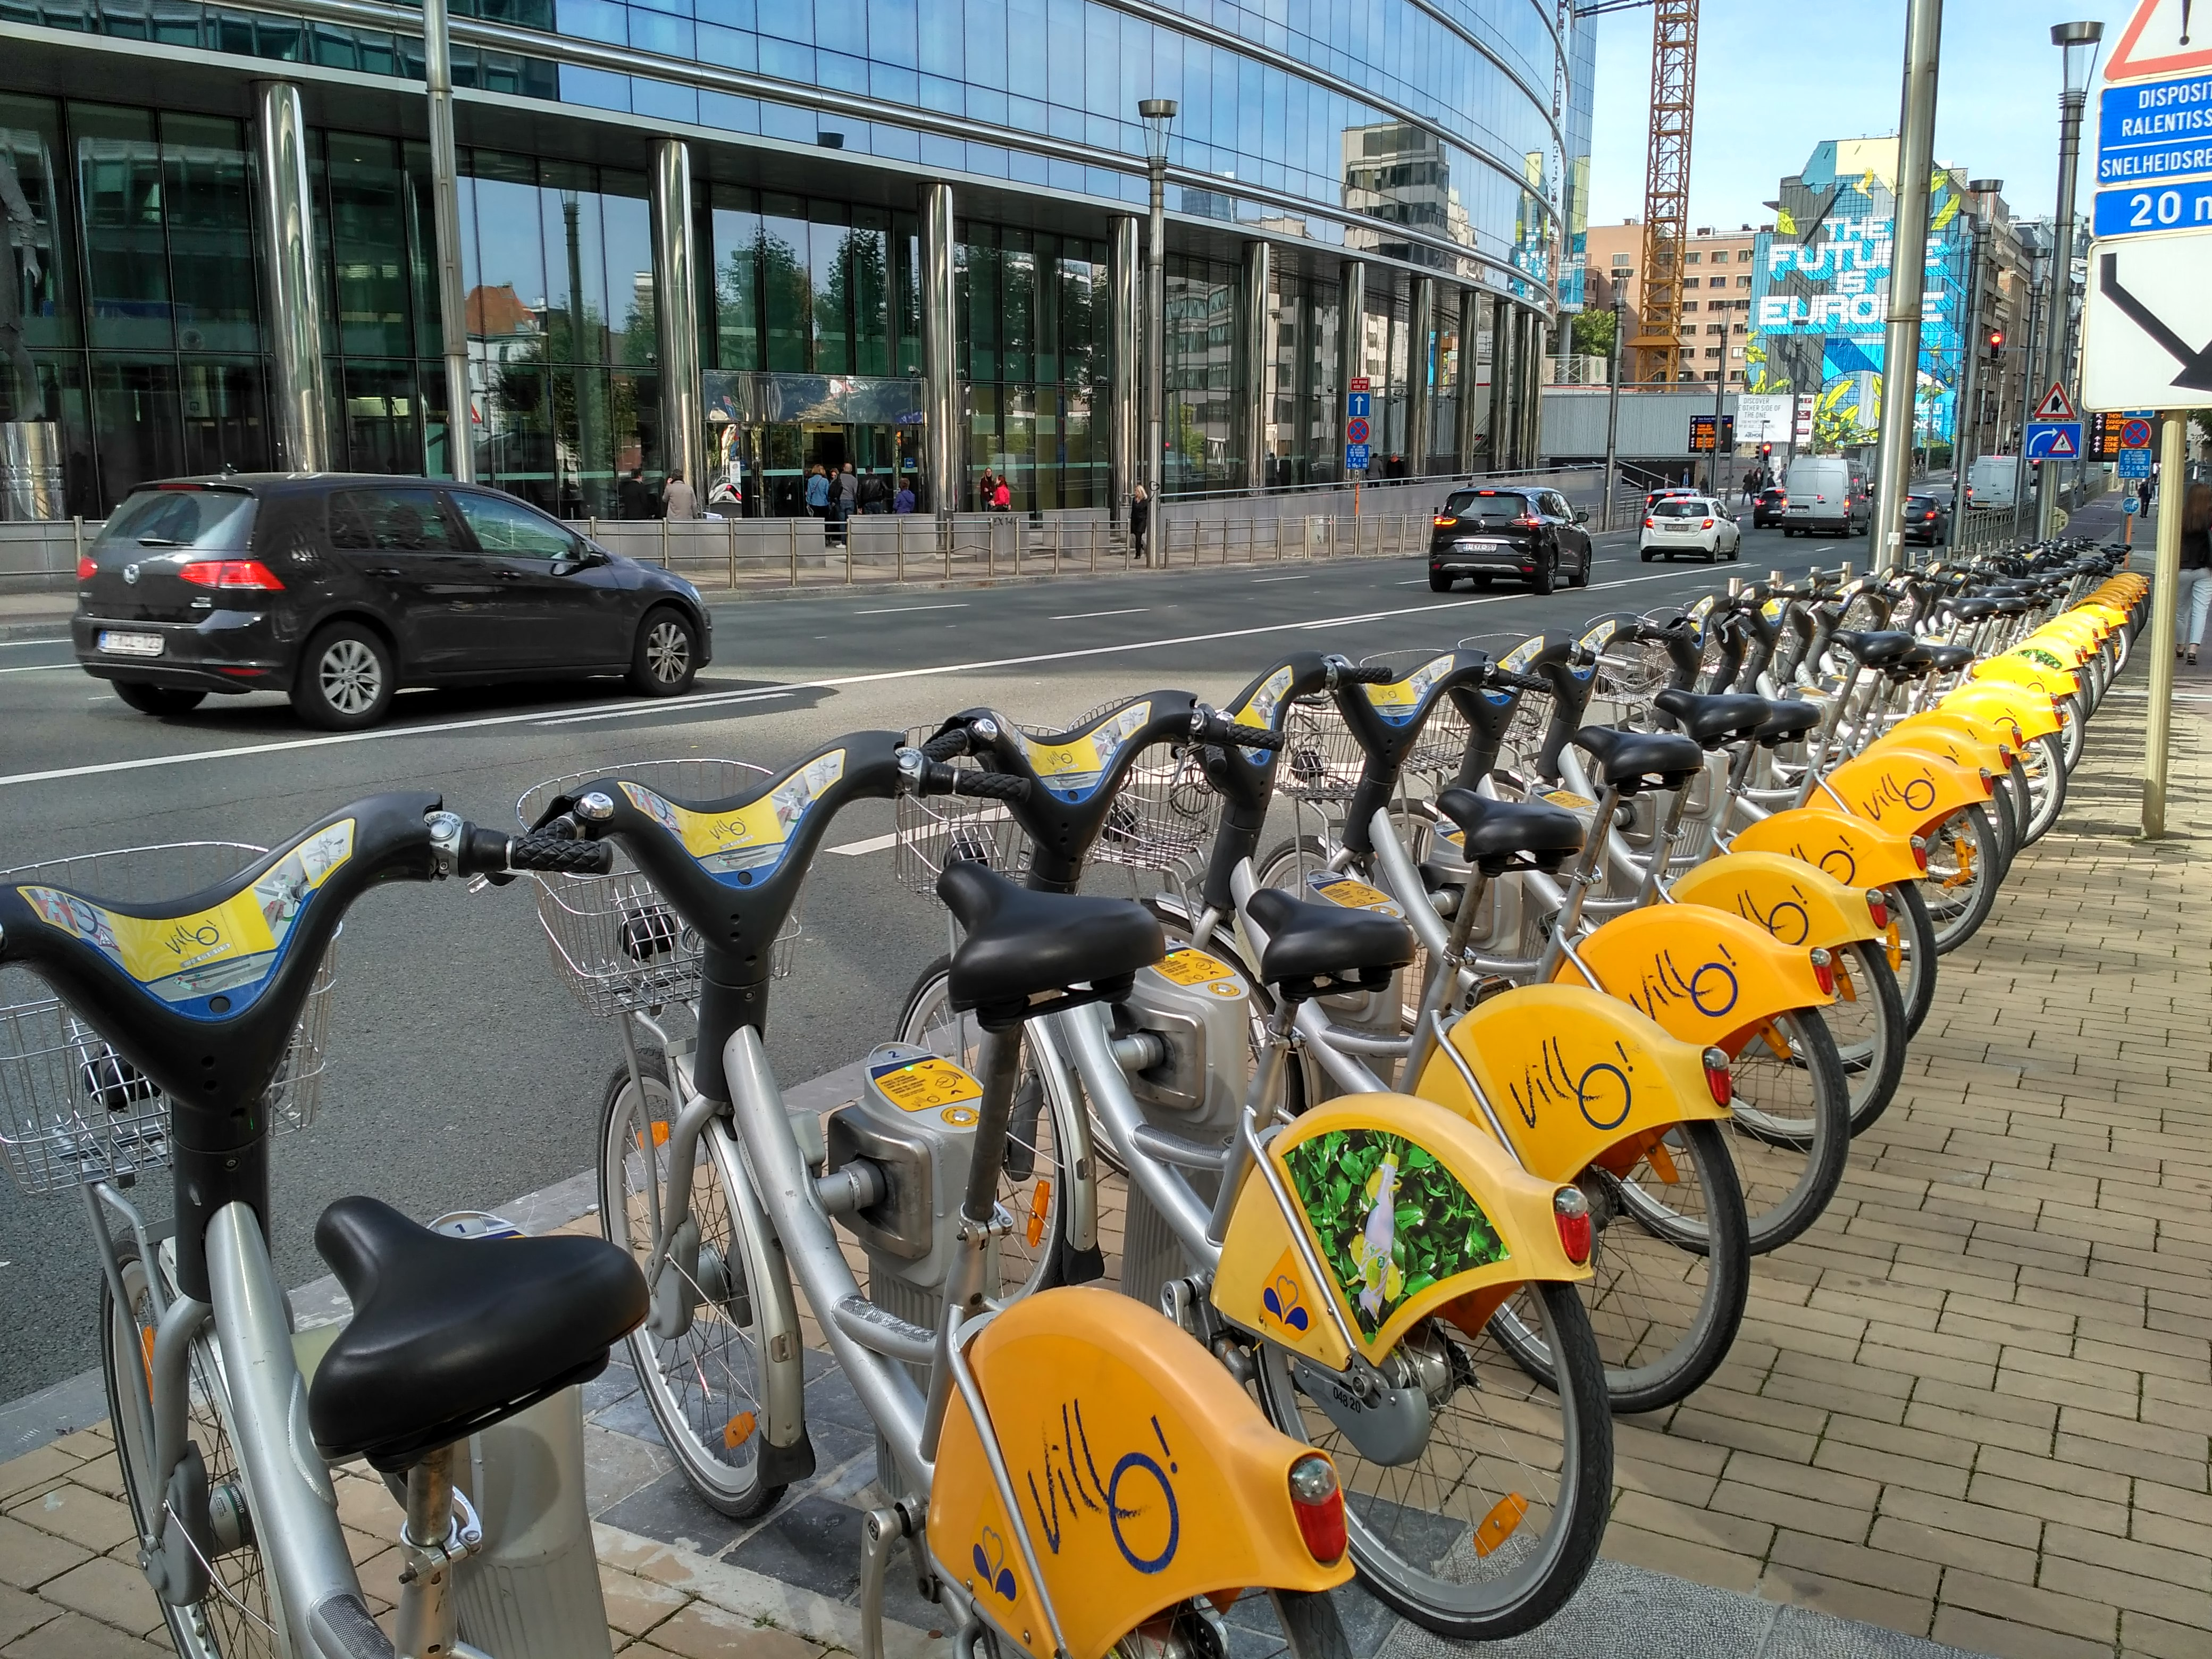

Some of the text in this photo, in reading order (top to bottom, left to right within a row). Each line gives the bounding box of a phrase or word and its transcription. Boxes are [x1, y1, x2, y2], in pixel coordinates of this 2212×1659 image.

[2130, 191, 2181, 227] 20
[1822, 216, 1892, 241] THE
[1769, 239, 1941, 272] FUTUE
[1836, 270, 1867, 294] IS
[455, 1223, 466, 1233] 1
[1333, 1386, 1361, 1414] 048 20
[229, 1486, 245, 1514] SHIMANO
